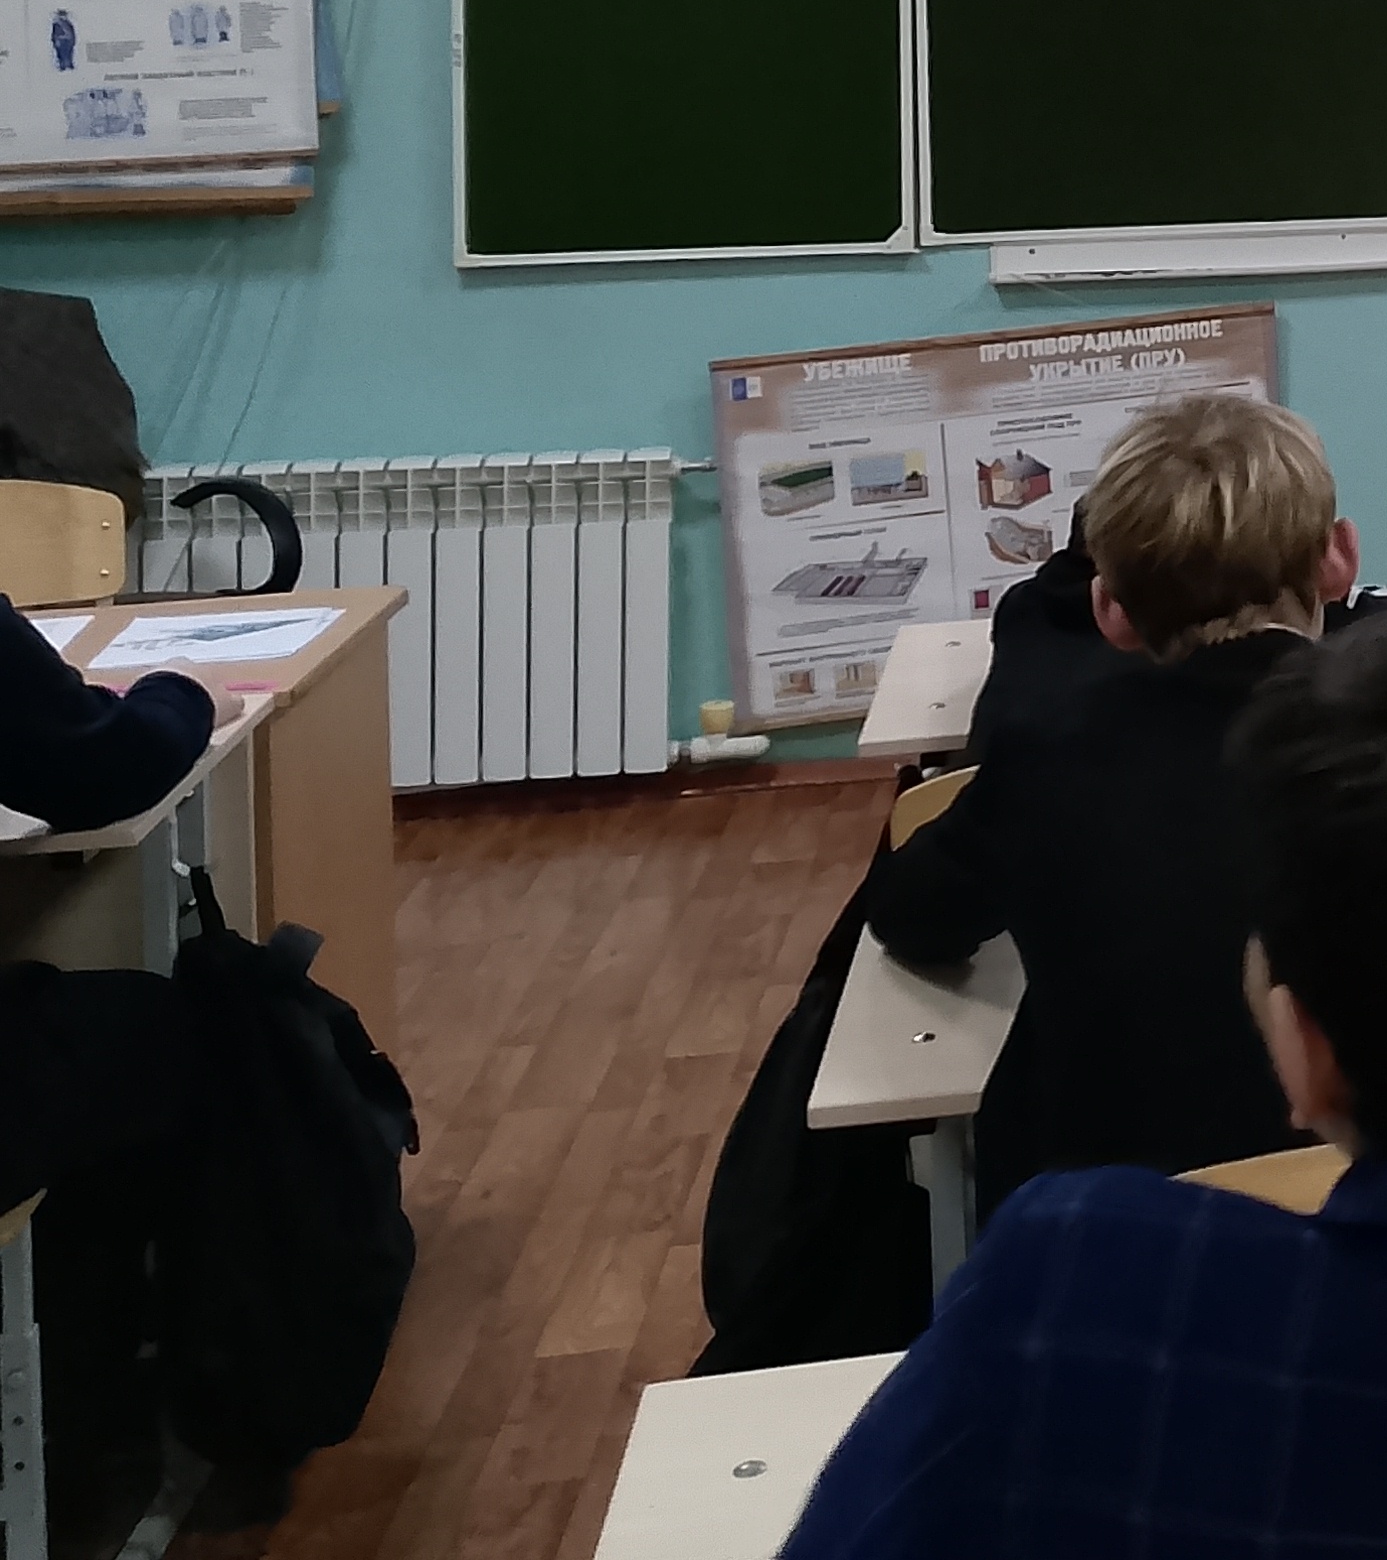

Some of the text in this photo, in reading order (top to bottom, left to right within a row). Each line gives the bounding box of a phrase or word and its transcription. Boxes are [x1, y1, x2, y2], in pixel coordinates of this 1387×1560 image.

[979, 320, 1224, 363] ПРОТИВОРАДИАЦИОННОЕ
[802, 352, 913, 383] УБЕЖИЩЕ
[1029, 347, 1187, 383] УКРЫТИЕ (ПРУ)
